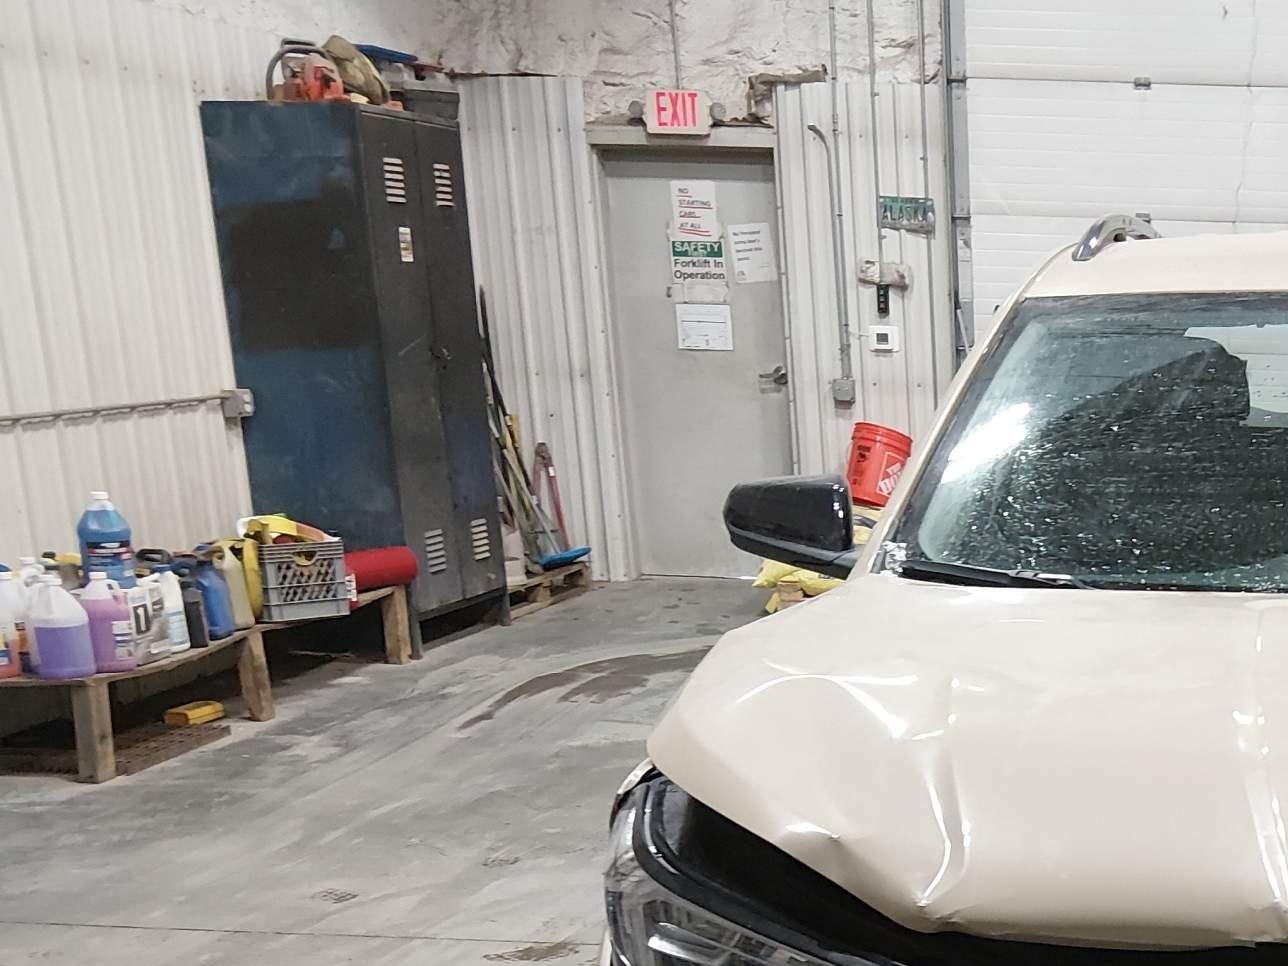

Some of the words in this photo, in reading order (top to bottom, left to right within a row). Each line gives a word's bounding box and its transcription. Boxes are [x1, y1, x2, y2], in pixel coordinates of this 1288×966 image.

[655, 92, 698, 127] EXIT
[881, 204, 927, 223] ALASKA
[674, 241, 720, 252] SAFETY
[673, 258, 711, 268] Forklift
[673, 270, 726, 281] Operation
